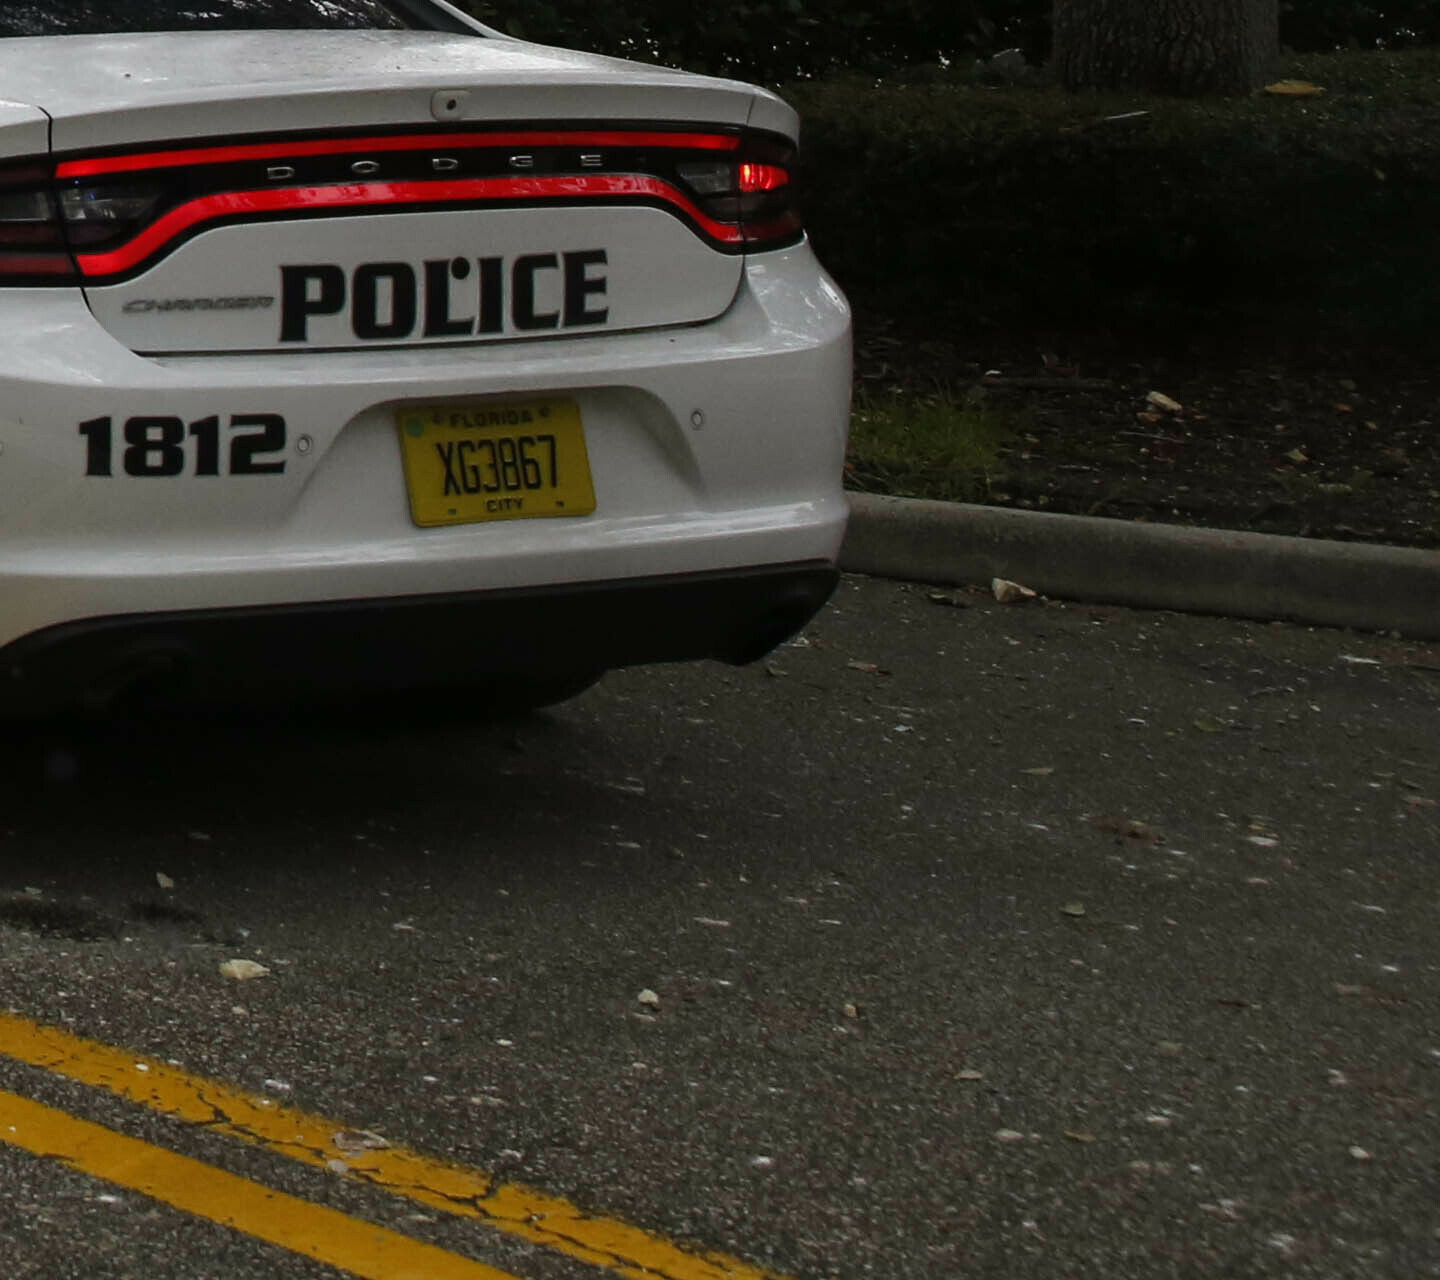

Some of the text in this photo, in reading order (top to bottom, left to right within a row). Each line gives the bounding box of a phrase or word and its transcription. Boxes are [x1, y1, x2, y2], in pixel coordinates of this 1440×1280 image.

[267, 154, 603, 180] DODGE
[122, 295, 277, 313] CHARGER
[280, 249, 609, 342] POLICE
[450, 410, 532, 428] FLORIDA
[78, 413, 287, 478] 1812
[435, 434, 560, 498] XG3867
[486, 496, 525, 514] CITY
